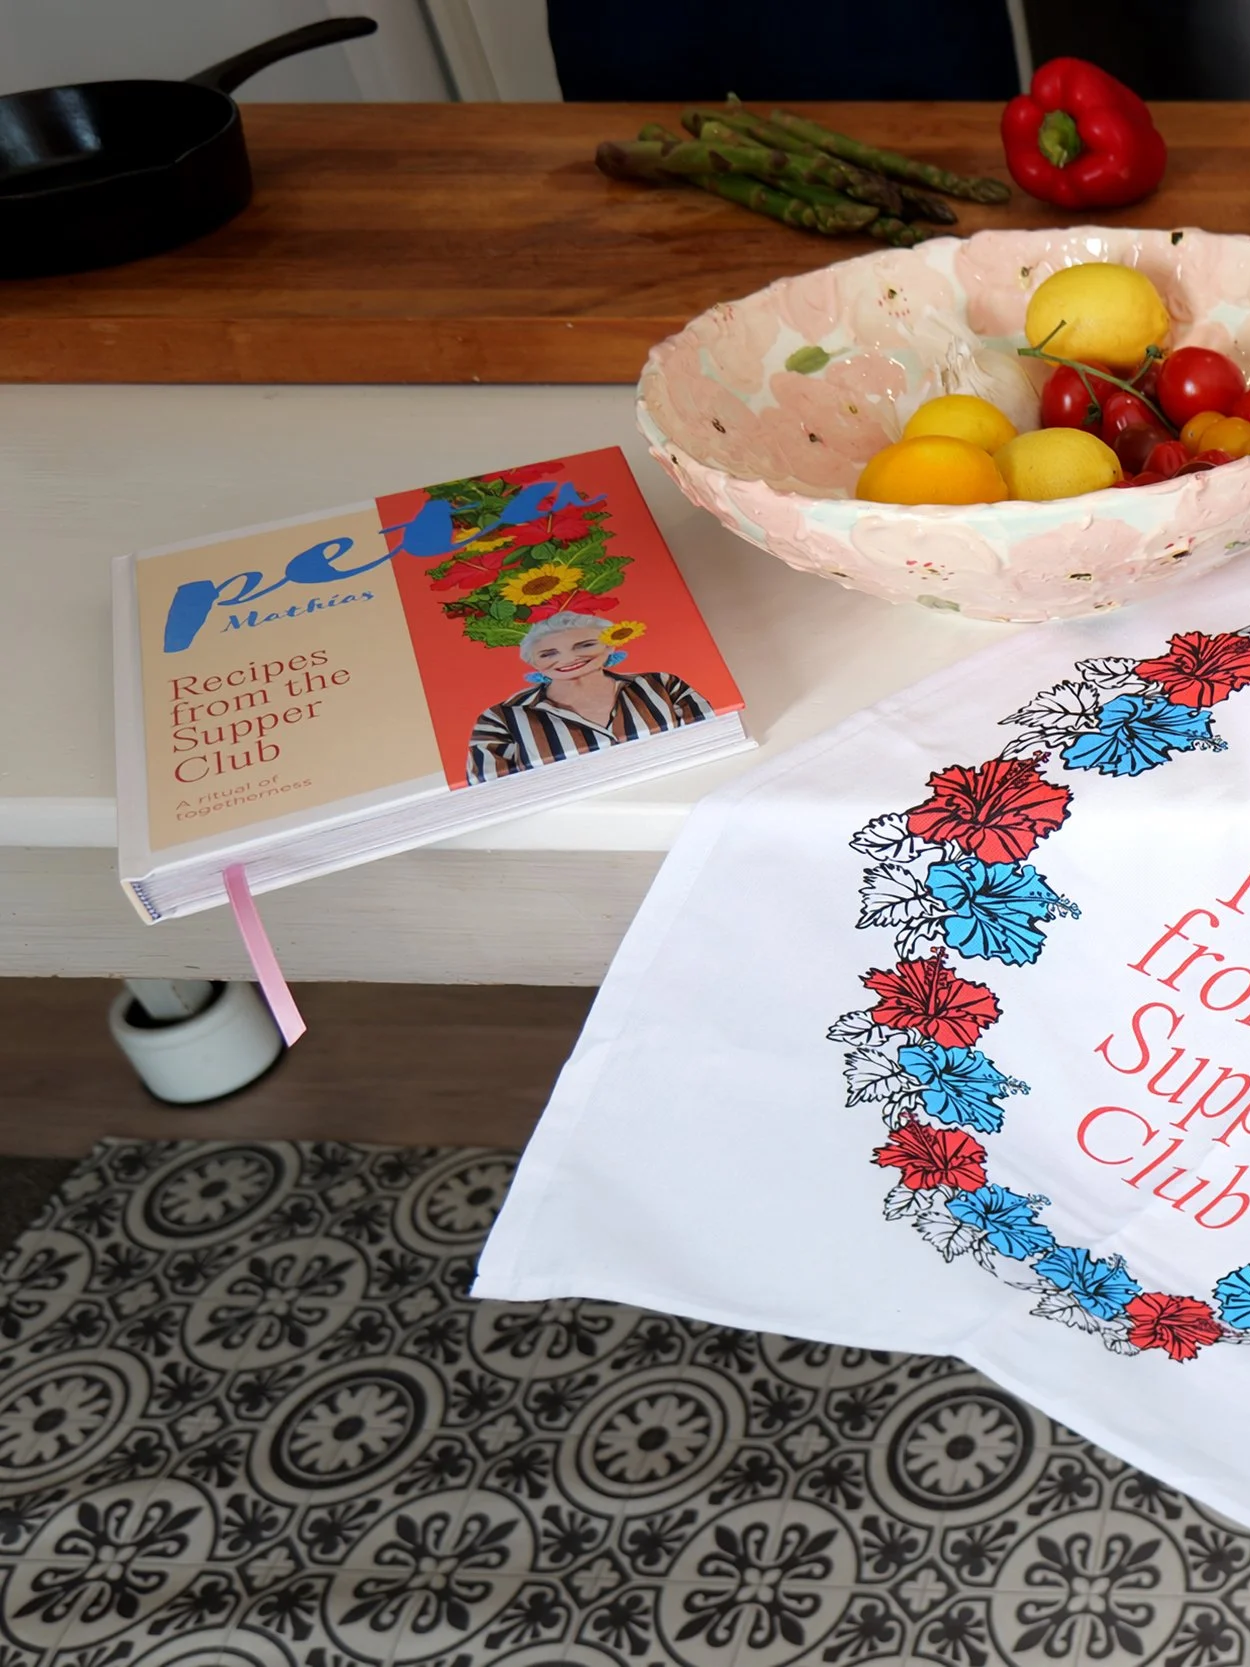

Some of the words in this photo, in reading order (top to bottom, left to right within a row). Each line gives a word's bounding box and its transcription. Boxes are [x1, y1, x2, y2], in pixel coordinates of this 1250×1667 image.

[163, 481, 608, 653] peta
[220, 590, 375, 633] Mathias
[168, 649, 329, 701] Recipes
[170, 688, 270, 727] from
[285, 668, 351, 697] the
[172, 700, 323, 753] Supper
[174, 740, 280, 783] Club
[176, 800, 191, 811] A
[198, 781, 250, 805] ritual
[257, 775, 279, 787] of
[176, 777, 313, 821] togetherness
